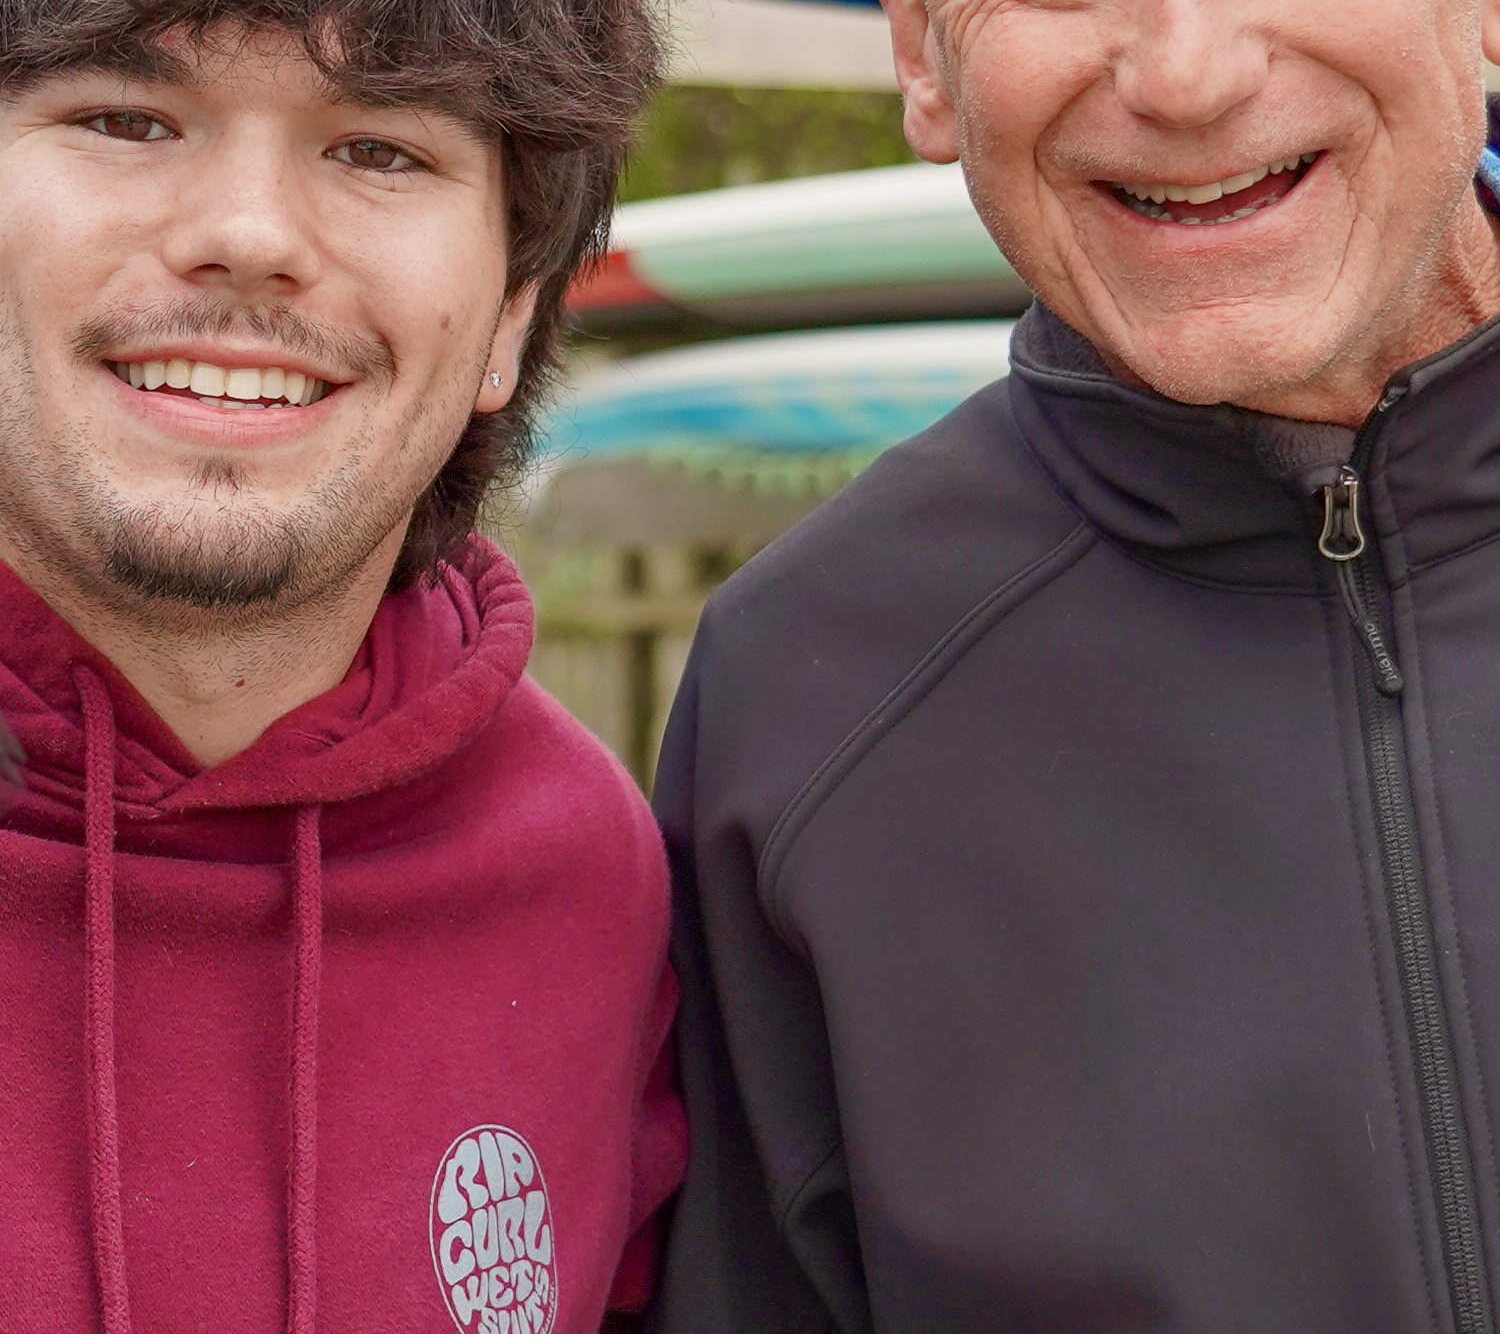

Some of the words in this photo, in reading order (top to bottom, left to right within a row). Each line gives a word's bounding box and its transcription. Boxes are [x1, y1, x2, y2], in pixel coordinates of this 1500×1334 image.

[1364, 623, 1398, 681] Marmo
[437, 1130, 535, 1224] RIP
[439, 1190, 551, 1284] CURL
[451, 1259, 533, 1325] WET
